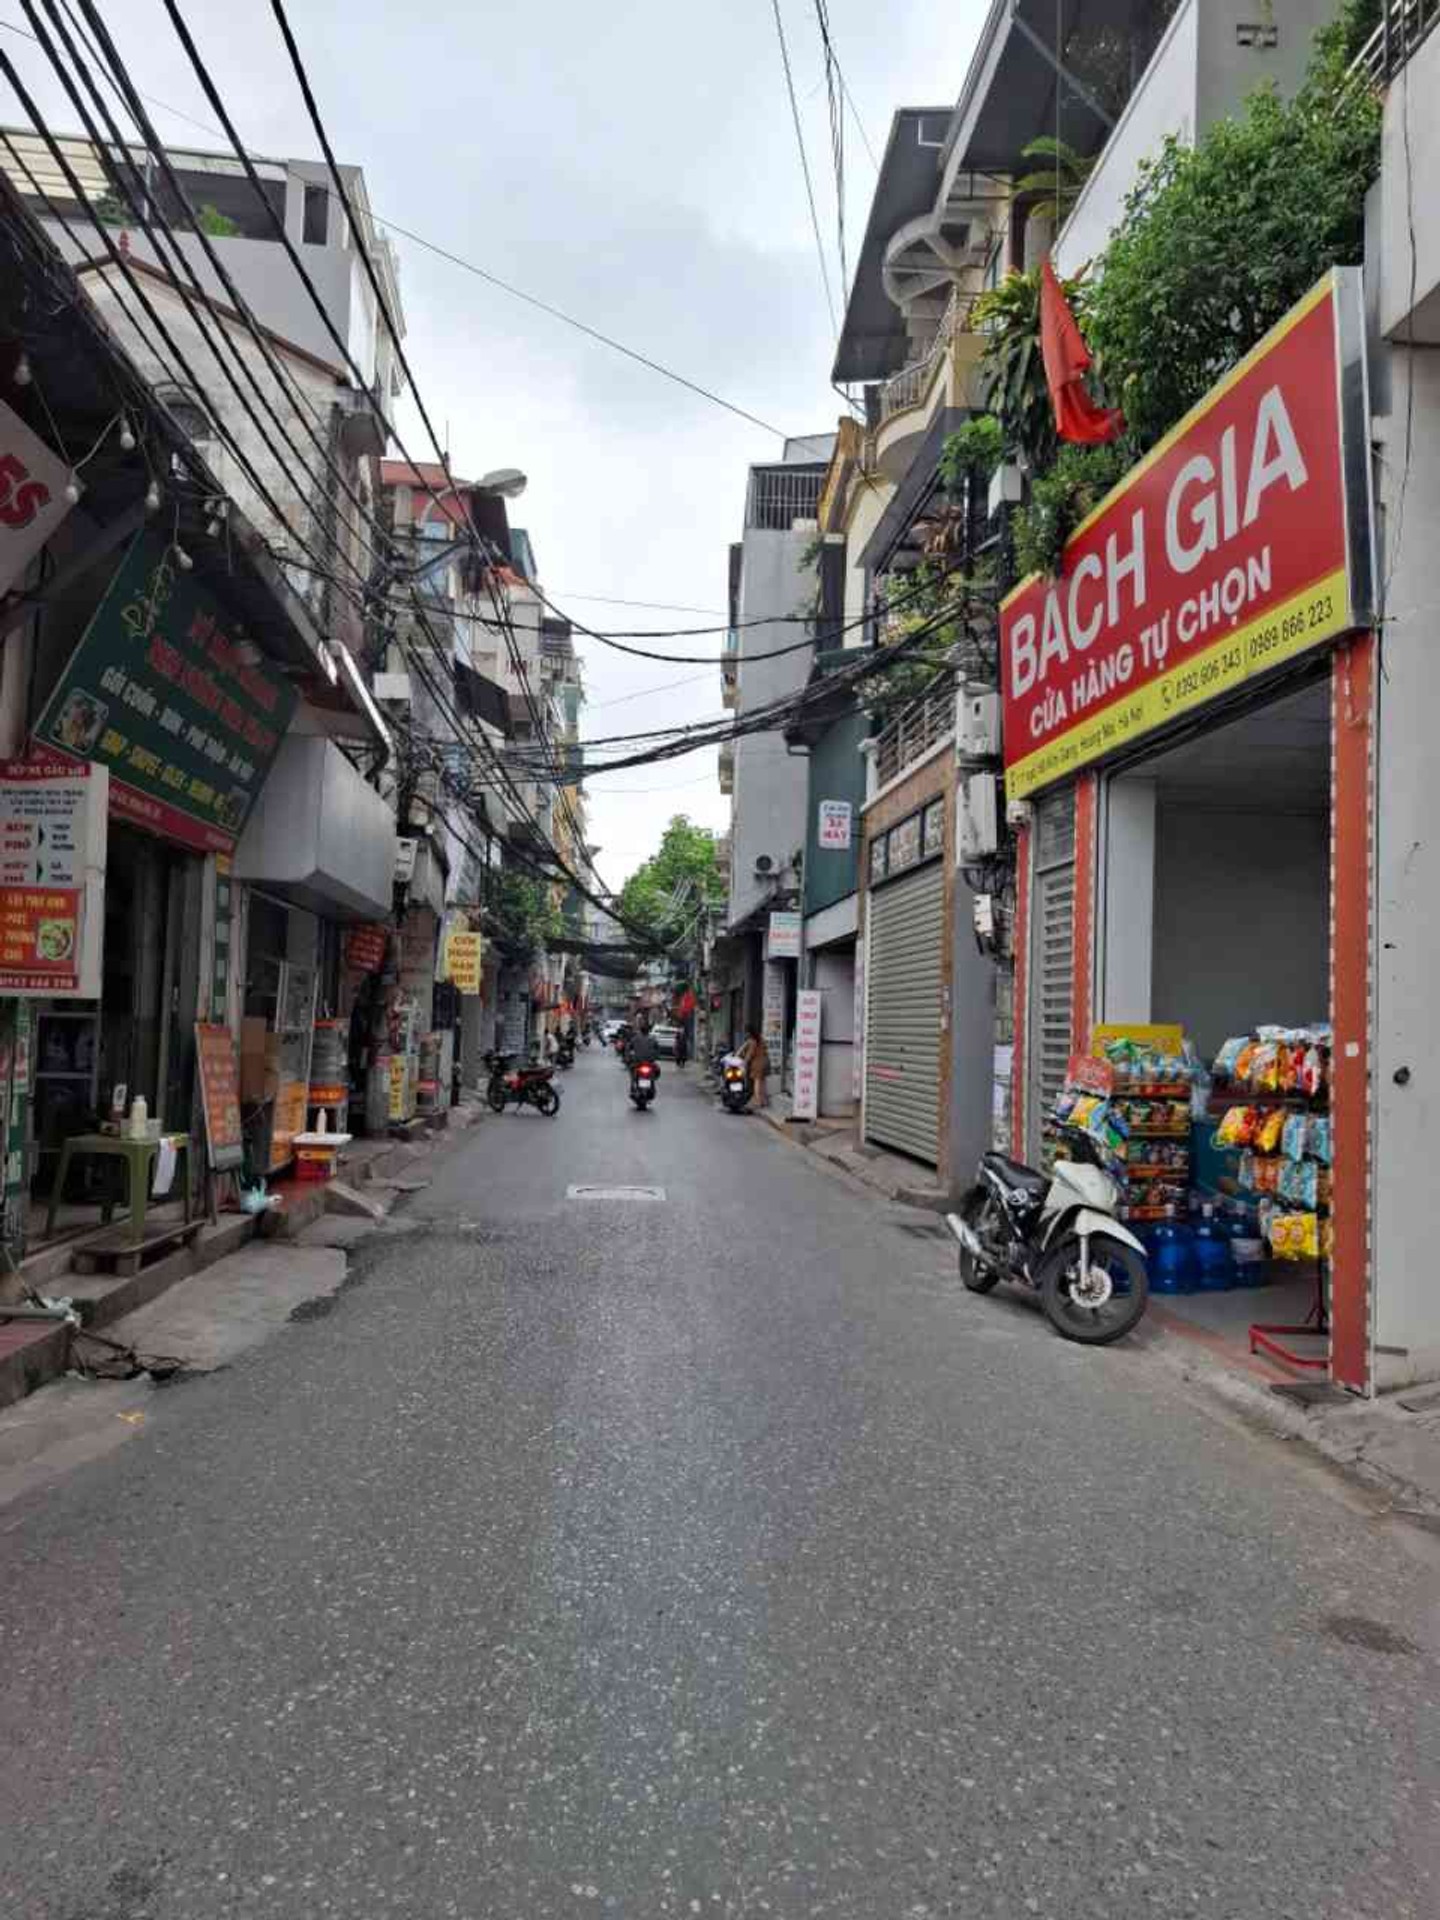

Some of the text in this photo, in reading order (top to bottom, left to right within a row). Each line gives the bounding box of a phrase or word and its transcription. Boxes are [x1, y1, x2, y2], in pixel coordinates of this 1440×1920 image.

[1165, 384, 1309, 574] GIA
[1030, 544, 1272, 738] CỬA HÀNG TỰ CHỌN
